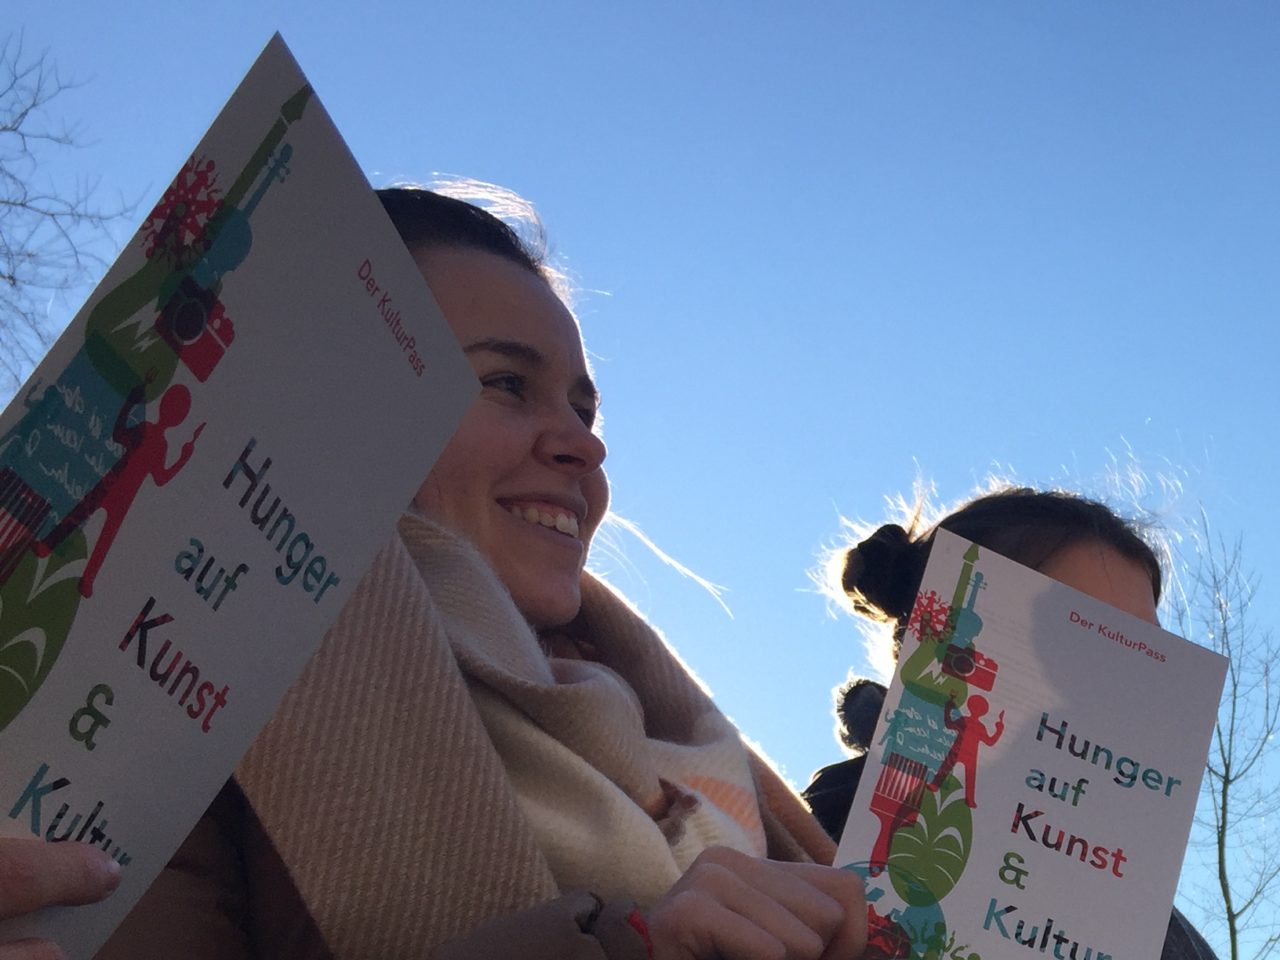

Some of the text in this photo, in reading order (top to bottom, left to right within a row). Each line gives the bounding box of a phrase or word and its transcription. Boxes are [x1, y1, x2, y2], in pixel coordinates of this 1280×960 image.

[358, 259, 425, 376] Der KulturPass
[222, 437, 341, 604] Hunger
[174, 537, 249, 612] auf
[118, 596, 230, 733] Kunst
[1069, 611, 1167, 662] Der KulturPass
[69, 683, 115, 751] &
[1035, 711, 1182, 798] Hunger
[1025, 765, 1088, 807] auf
[998, 849, 1029, 890] &
[1010, 802, 1128, 877] Kunst
